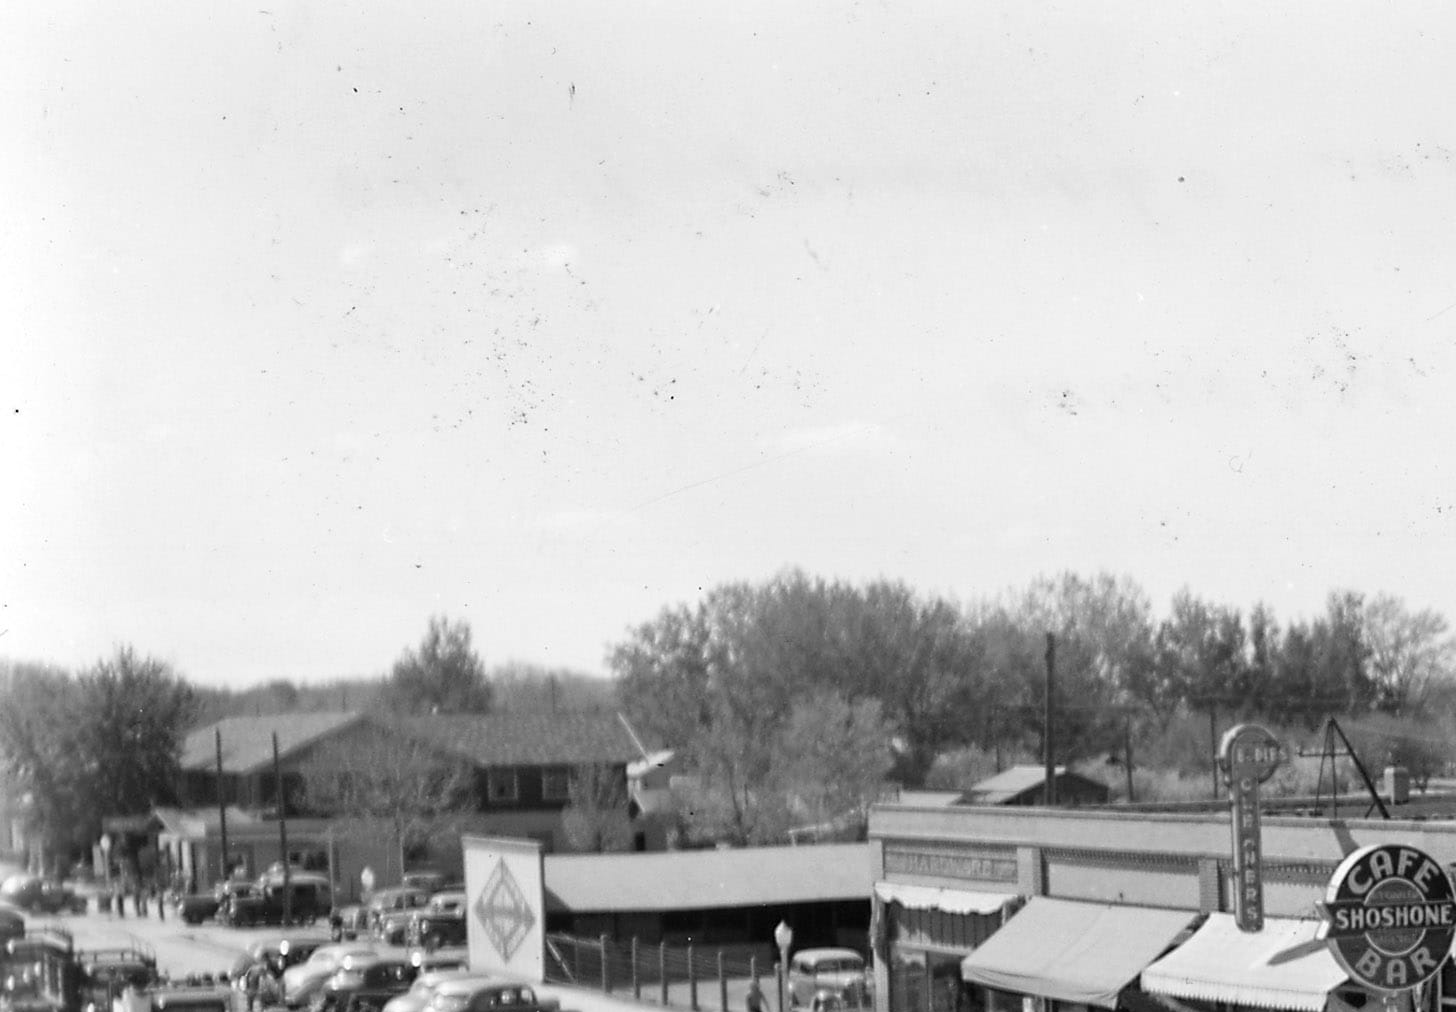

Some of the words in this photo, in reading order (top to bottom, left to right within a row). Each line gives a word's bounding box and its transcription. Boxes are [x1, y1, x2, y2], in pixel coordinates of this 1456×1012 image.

[1347, 849, 1440, 894] CAFE
[1335, 904, 1453, 930] SHOSHONE
[1355, 946, 1437, 985] BAR
